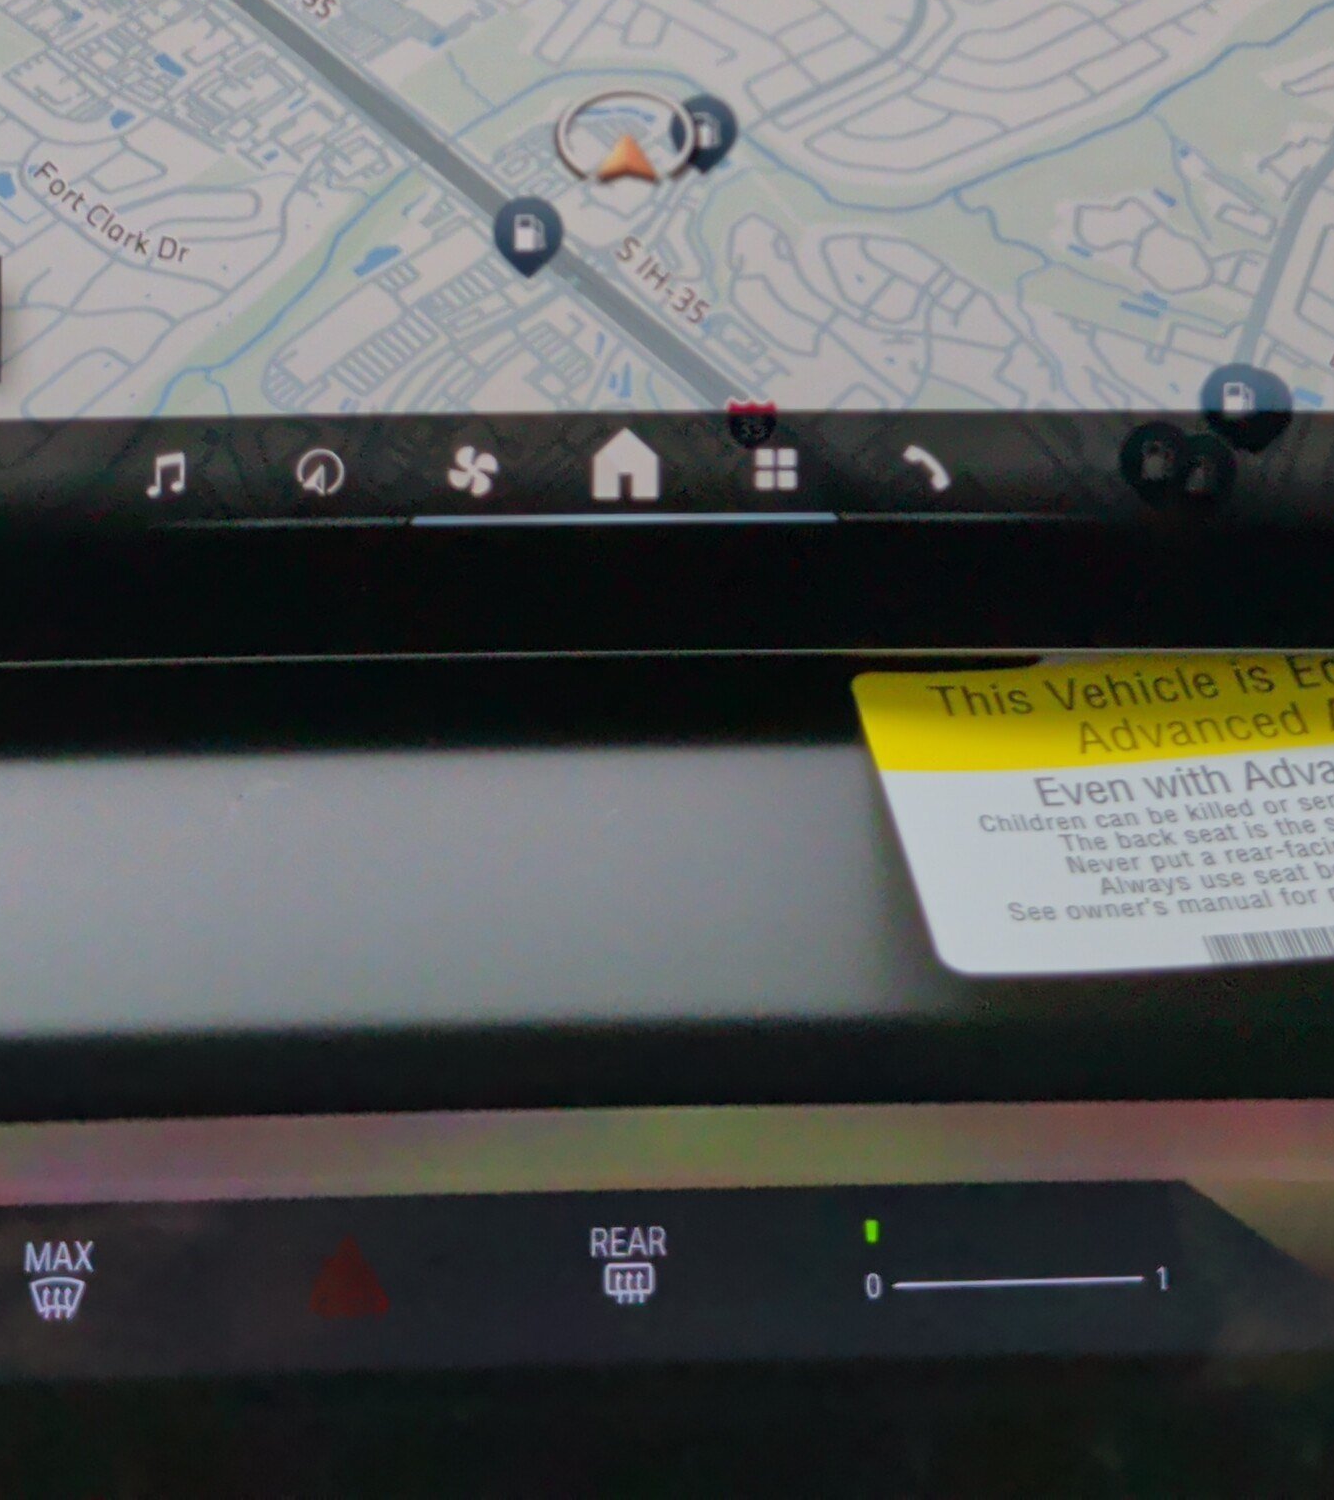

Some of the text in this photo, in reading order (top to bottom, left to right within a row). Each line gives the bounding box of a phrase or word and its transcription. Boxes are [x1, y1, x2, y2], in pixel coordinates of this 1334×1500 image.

[33, 161, 190, 262] Fort Clark Dr
[613, 236, 710, 324] S IH-35
[926, 682, 1034, 716] This
[1043, 667, 1219, 711] Vehicle
[1229, 659, 1275, 695] is
[1079, 701, 1310, 754] Advanced
[1033, 776, 1136, 807] Even
[1141, 764, 1232, 800] with
[978, 813, 1087, 833] Children
[1094, 811, 1140, 829] can
[1145, 806, 1179, 825] be
[1184, 799, 1255, 822] killed
[1262, 798, 1288, 816] or
[1058, 833, 1108, 852] The
[1114, 828, 1177, 849] back
[1183, 823, 1239, 844] seat
[1243, 820, 1269, 839] is
[1274, 817, 1317, 837] the
[1065, 854, 1141, 874] Never
[1150, 850, 1195, 873] put
[1200, 850, 1217, 866] a
[1100, 875, 1192, 896] Always
[1199, 870, 1246, 889] use
[1253, 863, 1310, 885] seat
[1007, 901, 1057, 922] See
[1065, 897, 1169, 921] owner's
[1176, 889, 1273, 914] manual
[1278, 887, 1317, 907] for
[23, 1240, 94, 1272] MAX
[590, 1225, 667, 1257] REAR
[865, 1265, 1168, 1299] 0 1
